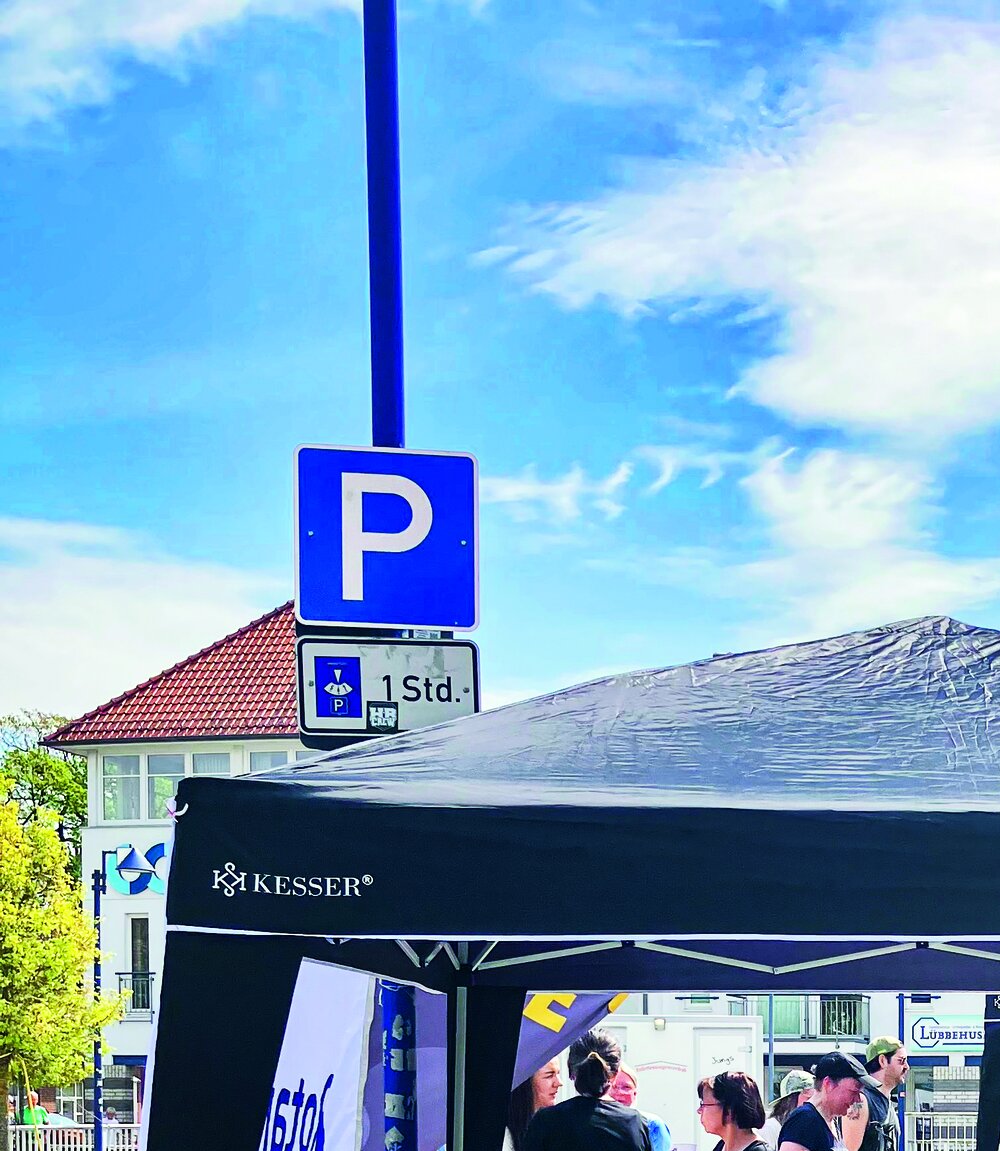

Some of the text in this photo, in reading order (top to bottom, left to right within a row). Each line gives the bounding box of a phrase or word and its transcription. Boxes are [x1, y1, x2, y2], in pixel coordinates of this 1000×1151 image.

[341, 472, 433, 601] P
[382, 674, 461, 703] 1 Std.
[334, 699, 344, 712] P
[920, 1025, 985, 1040] LÜBBEHUS
